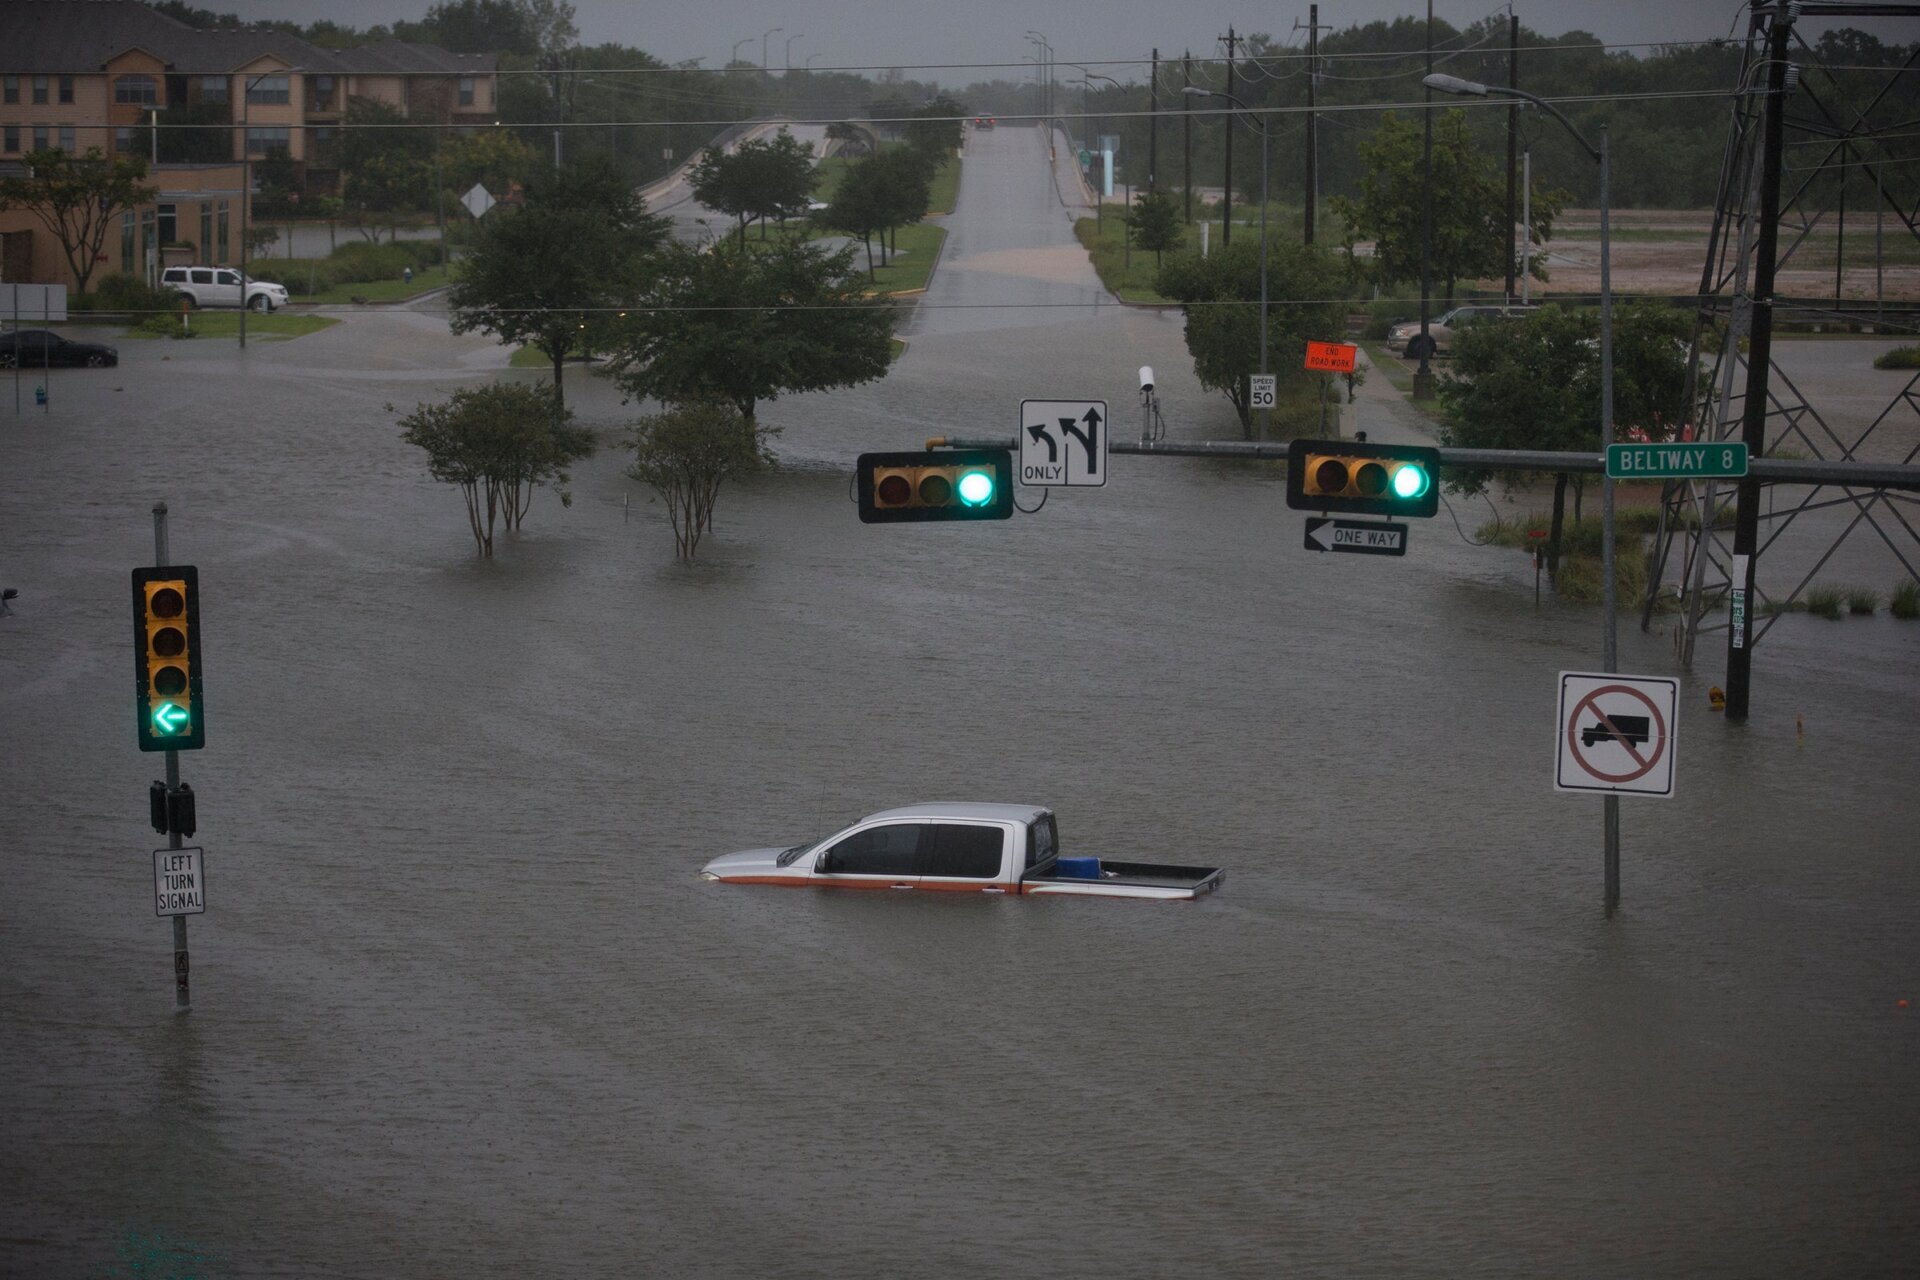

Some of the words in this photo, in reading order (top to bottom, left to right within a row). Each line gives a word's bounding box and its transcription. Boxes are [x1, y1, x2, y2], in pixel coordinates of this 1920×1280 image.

[1326, 347, 1339, 356] END
[1311, 357, 1329, 366] ROAD
[1331, 359, 1349, 367] WORK
[1253, 392, 1273, 405] 50
[1621, 450, 1705, 470] BELTWAY
[1722, 450, 1733, 469] 8
[1024, 466, 1062, 479] ONLY
[1334, 530, 1362, 543] ONE
[1367, 532, 1396, 545] WAY
[164, 855, 192, 871] LEFT
[164, 874, 194, 890] TURN
[159, 892, 201, 909] SIGNAL
